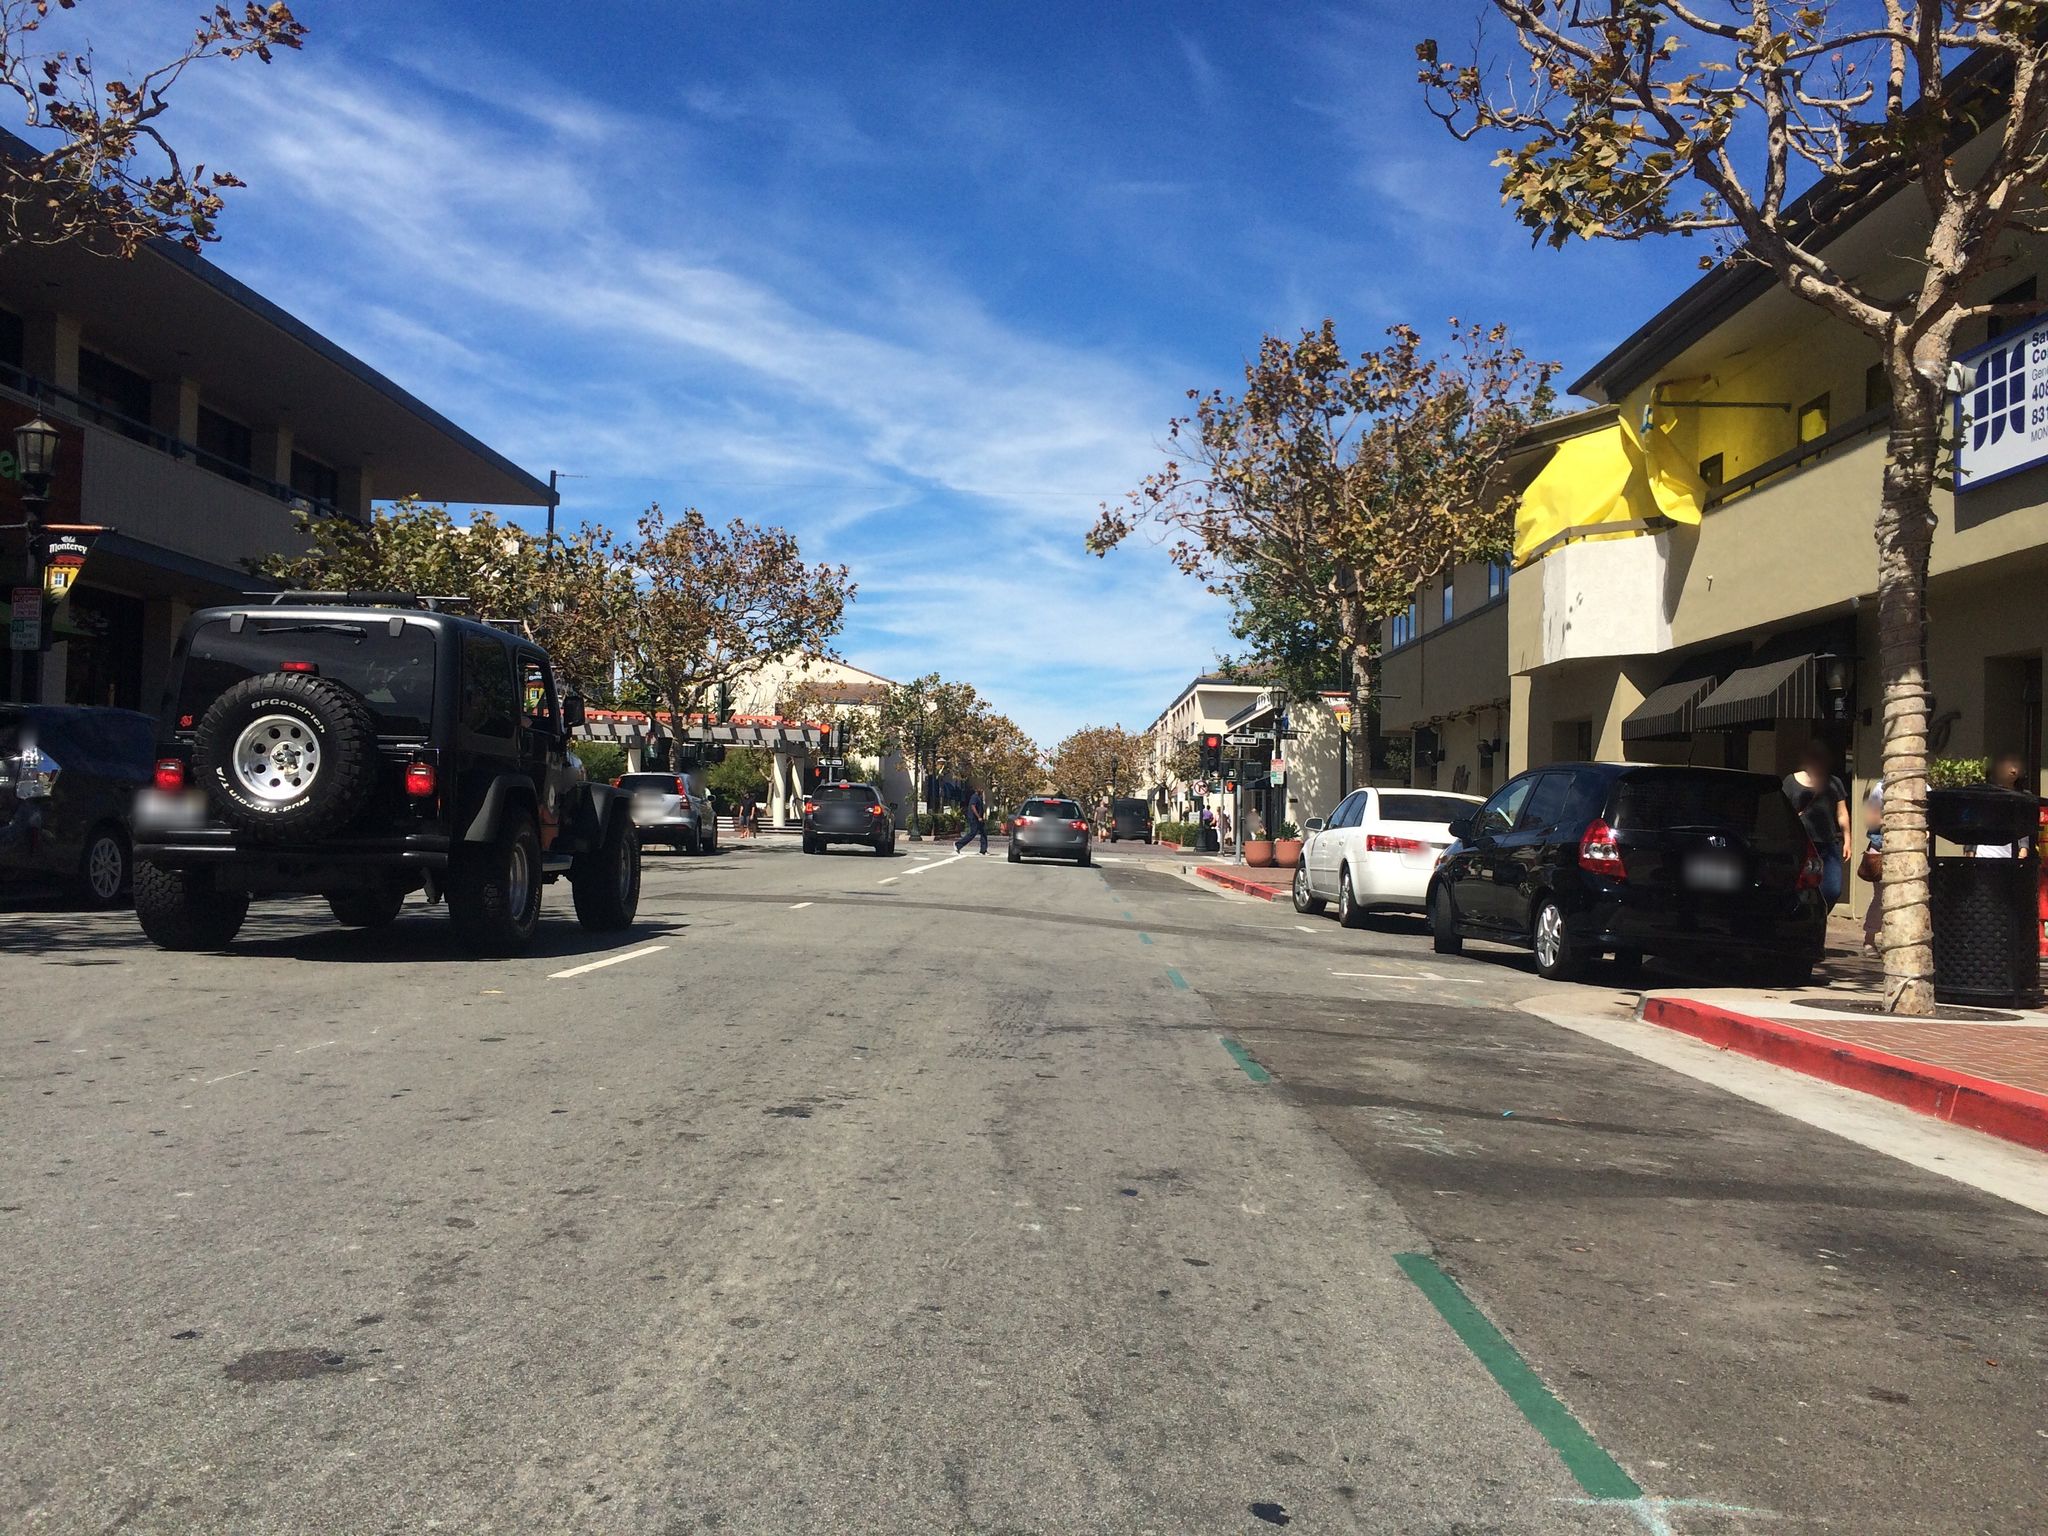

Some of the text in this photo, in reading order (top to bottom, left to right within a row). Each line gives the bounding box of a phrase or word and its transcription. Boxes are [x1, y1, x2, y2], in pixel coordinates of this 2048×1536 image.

[49, 543, 88, 555] Monterey
[251, 698, 326, 734] BFGoodrich
[228, 787, 311, 814] Mud-Terrain
